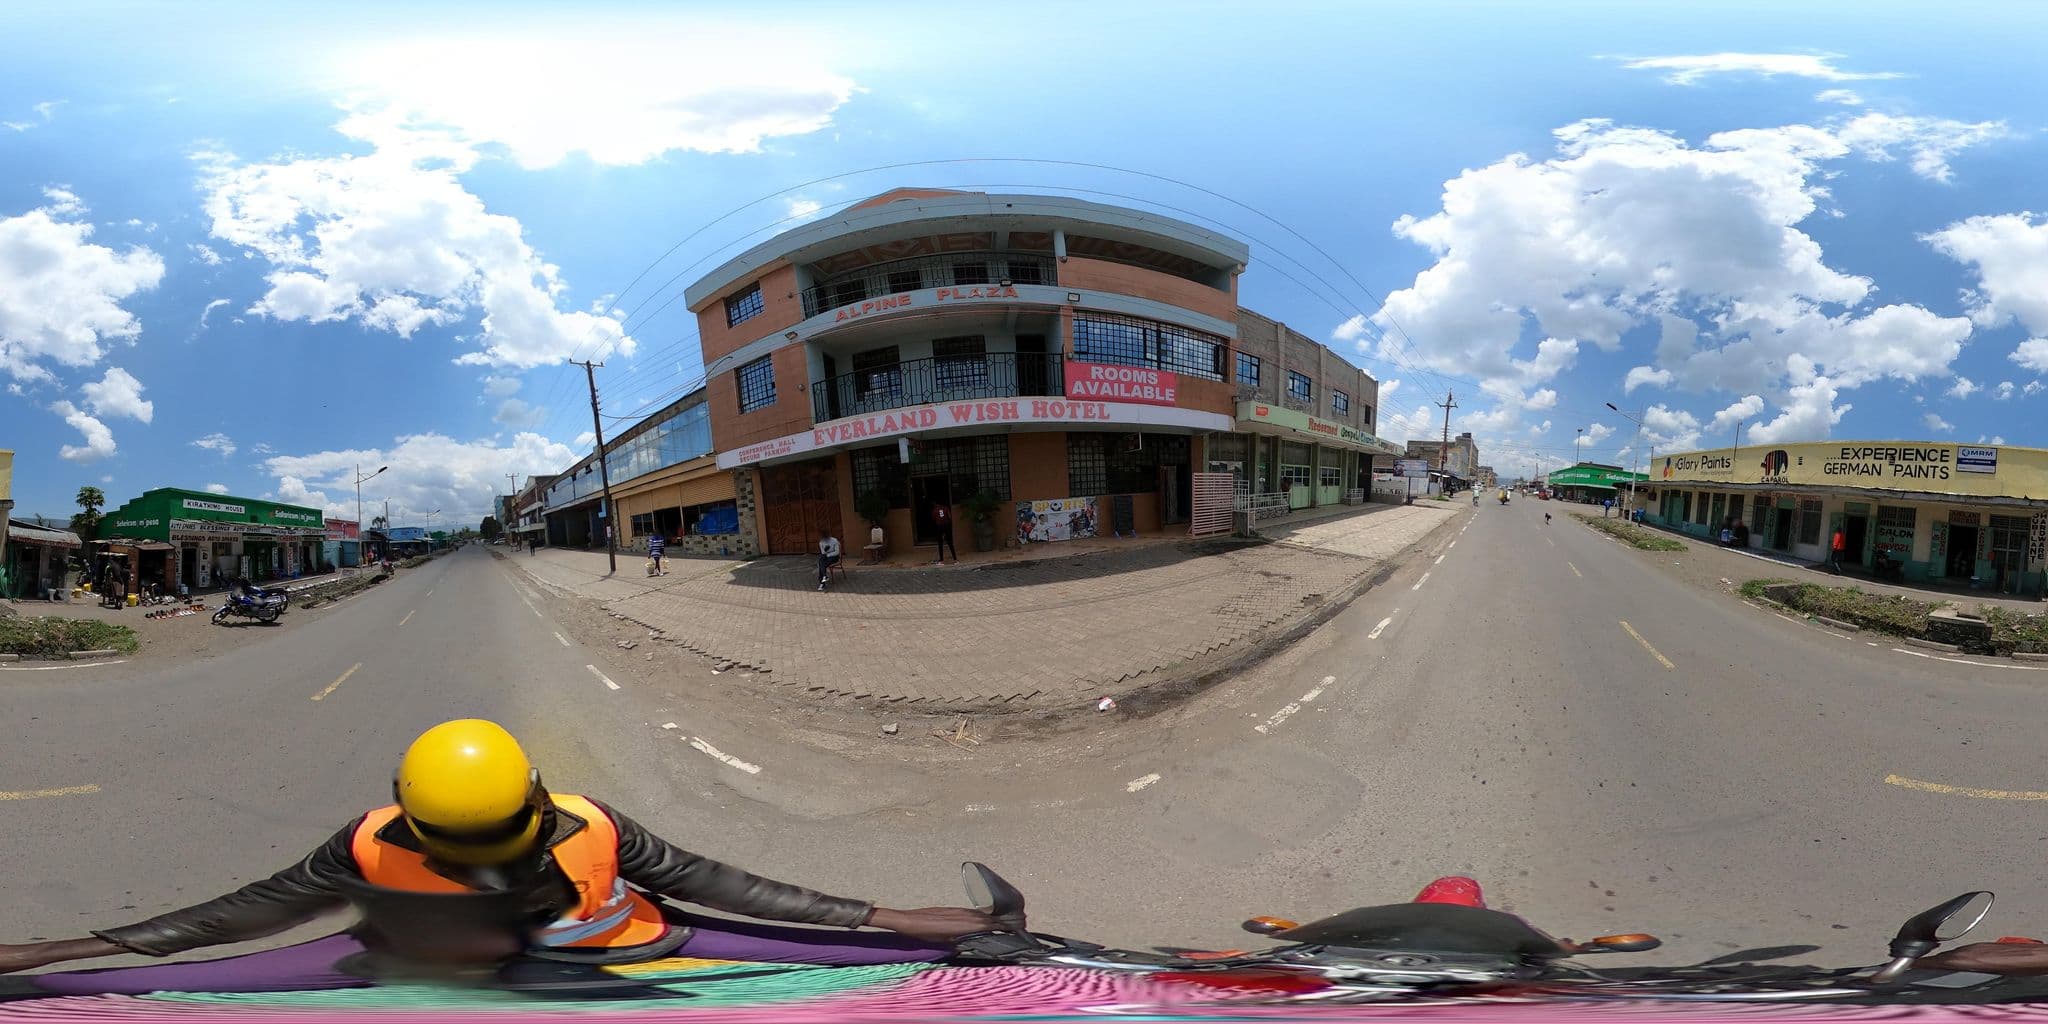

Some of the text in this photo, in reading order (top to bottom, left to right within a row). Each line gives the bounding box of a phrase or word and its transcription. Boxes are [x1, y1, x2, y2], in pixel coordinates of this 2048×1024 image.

[835, 286, 1019, 322] ALPINE PLAZA
[1090, 366, 1158, 385] ROOMS
[1071, 380, 1175, 402] AVAILABLE
[813, 408, 937, 446] EVERLAND
[949, 401, 1019, 423] WISH
[1031, 400, 1111, 420] HOTEL
[1307, 417, 1338, 436] Redeemed
[1341, 426, 1359, 442] Gospel
[1701, 455, 1731, 470] Paints
[1823, 462, 1949, 480] GERMAN PAINTS
[225, 505, 243, 513] HOUSE
[1879, 527, 1914, 539] SALON
[2037, 512, 2048, 560] HARDWARE
